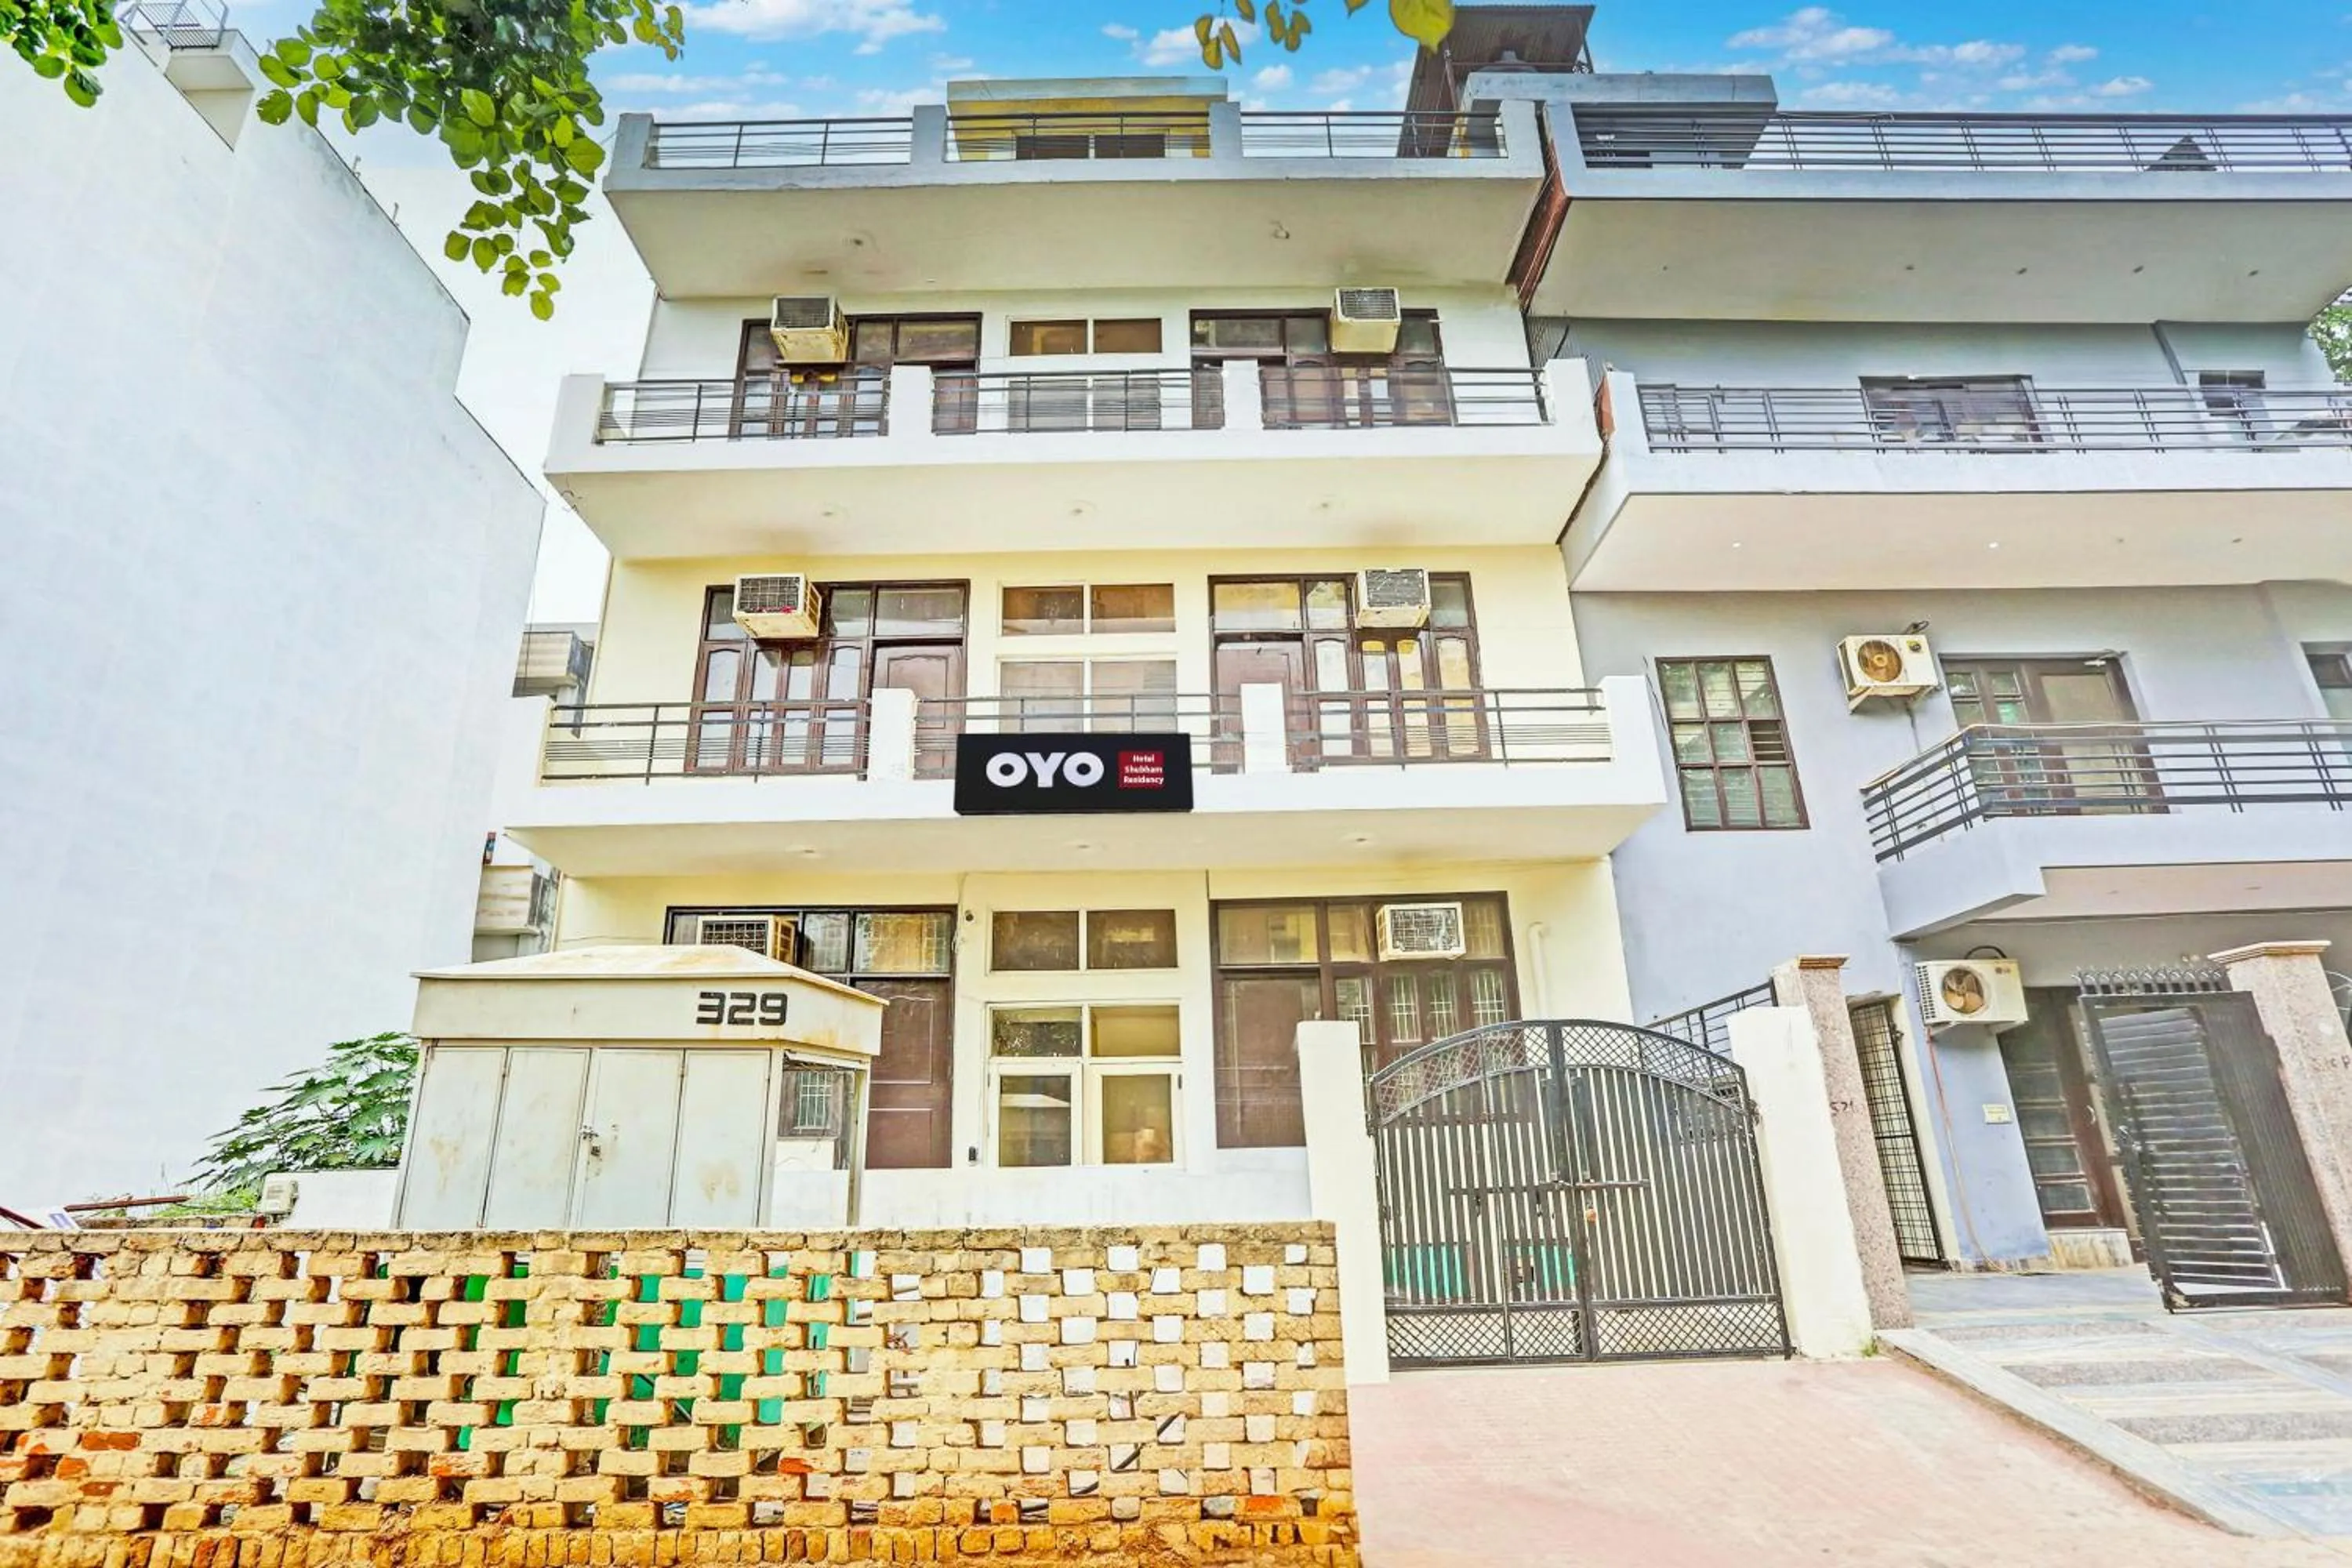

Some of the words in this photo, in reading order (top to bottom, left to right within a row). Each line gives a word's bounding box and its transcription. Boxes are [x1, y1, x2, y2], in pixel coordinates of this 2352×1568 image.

[1133, 753, 1155, 763] Hotel
[985, 752, 1105, 788] OYO
[1124, 764, 1163, 774] Shubham
[1123, 775, 1164, 785] Residency
[696, 991, 788, 1026] 329
